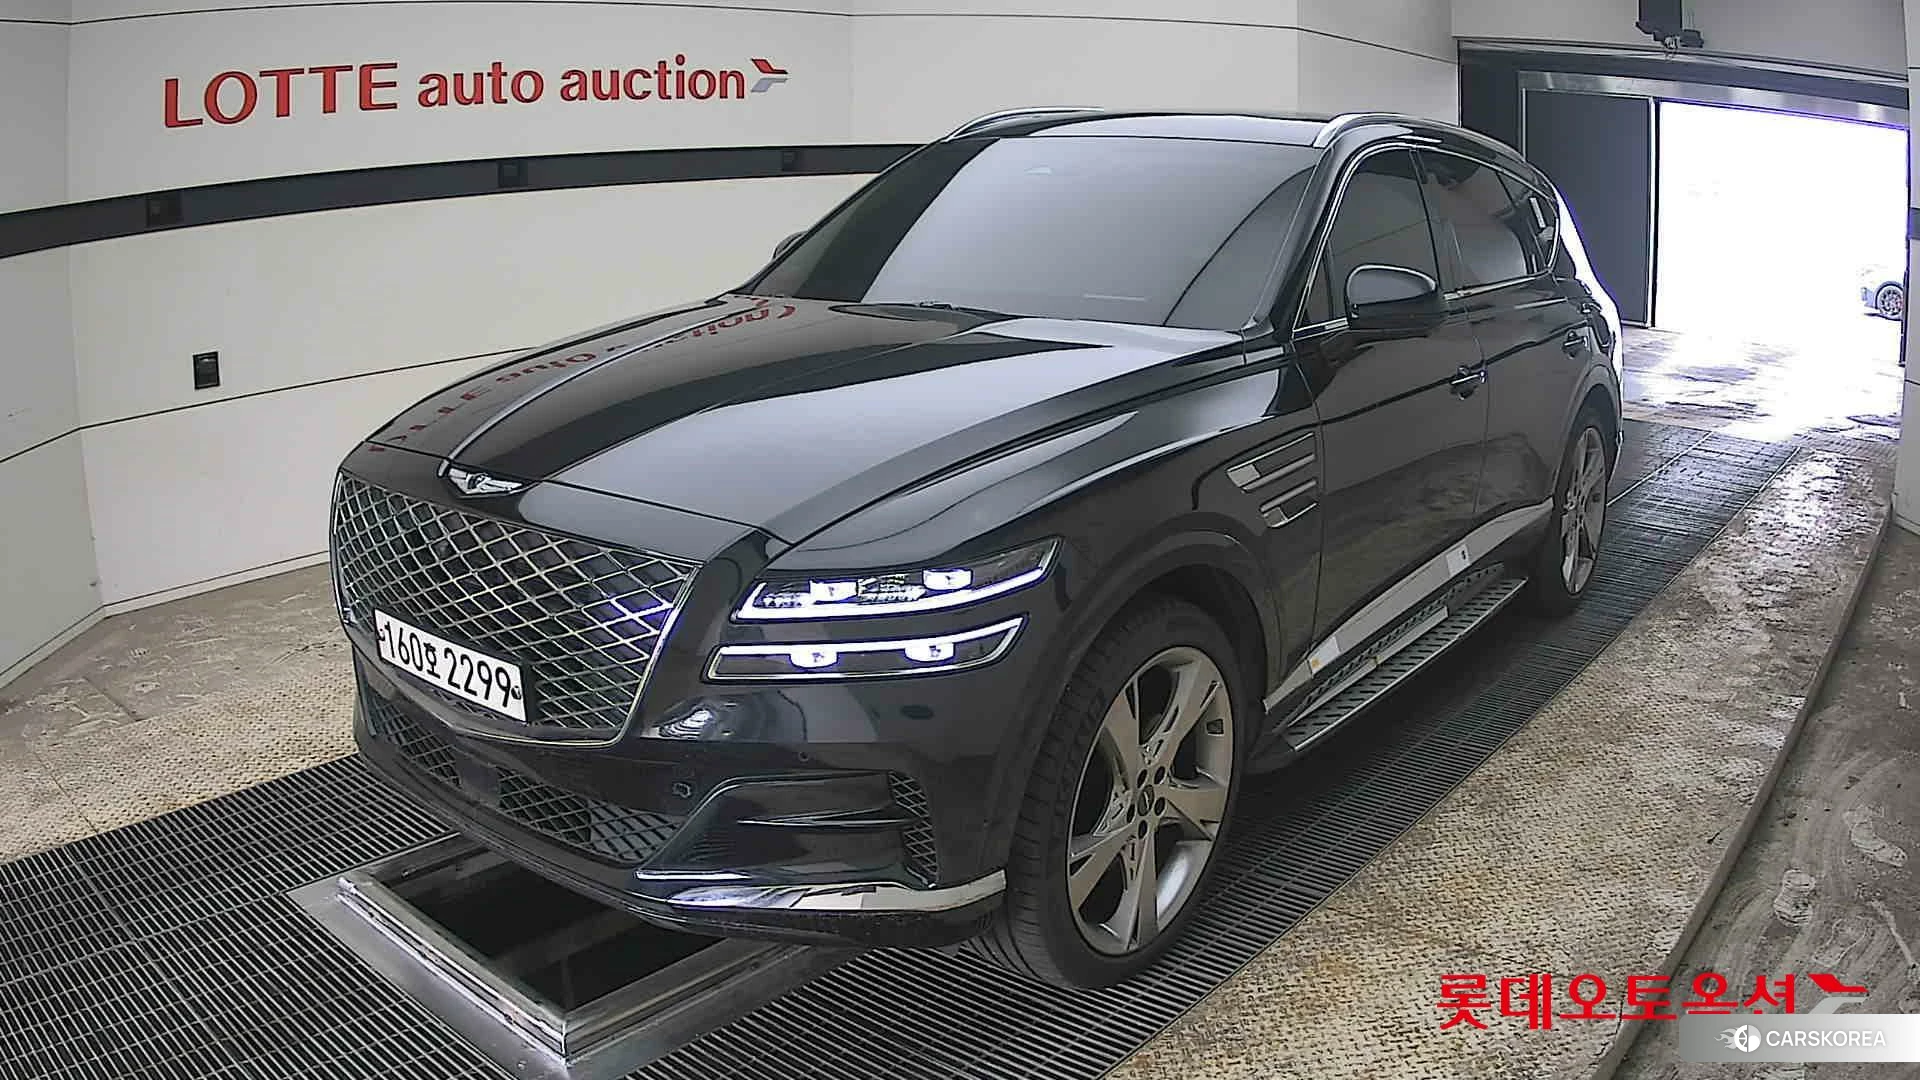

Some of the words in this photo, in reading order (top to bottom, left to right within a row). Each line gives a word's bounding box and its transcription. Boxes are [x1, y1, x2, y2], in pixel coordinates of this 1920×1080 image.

[165, 63, 397, 128] LOTTE
[417, 61, 544, 107] auto
[560, 54, 745, 101] auction
